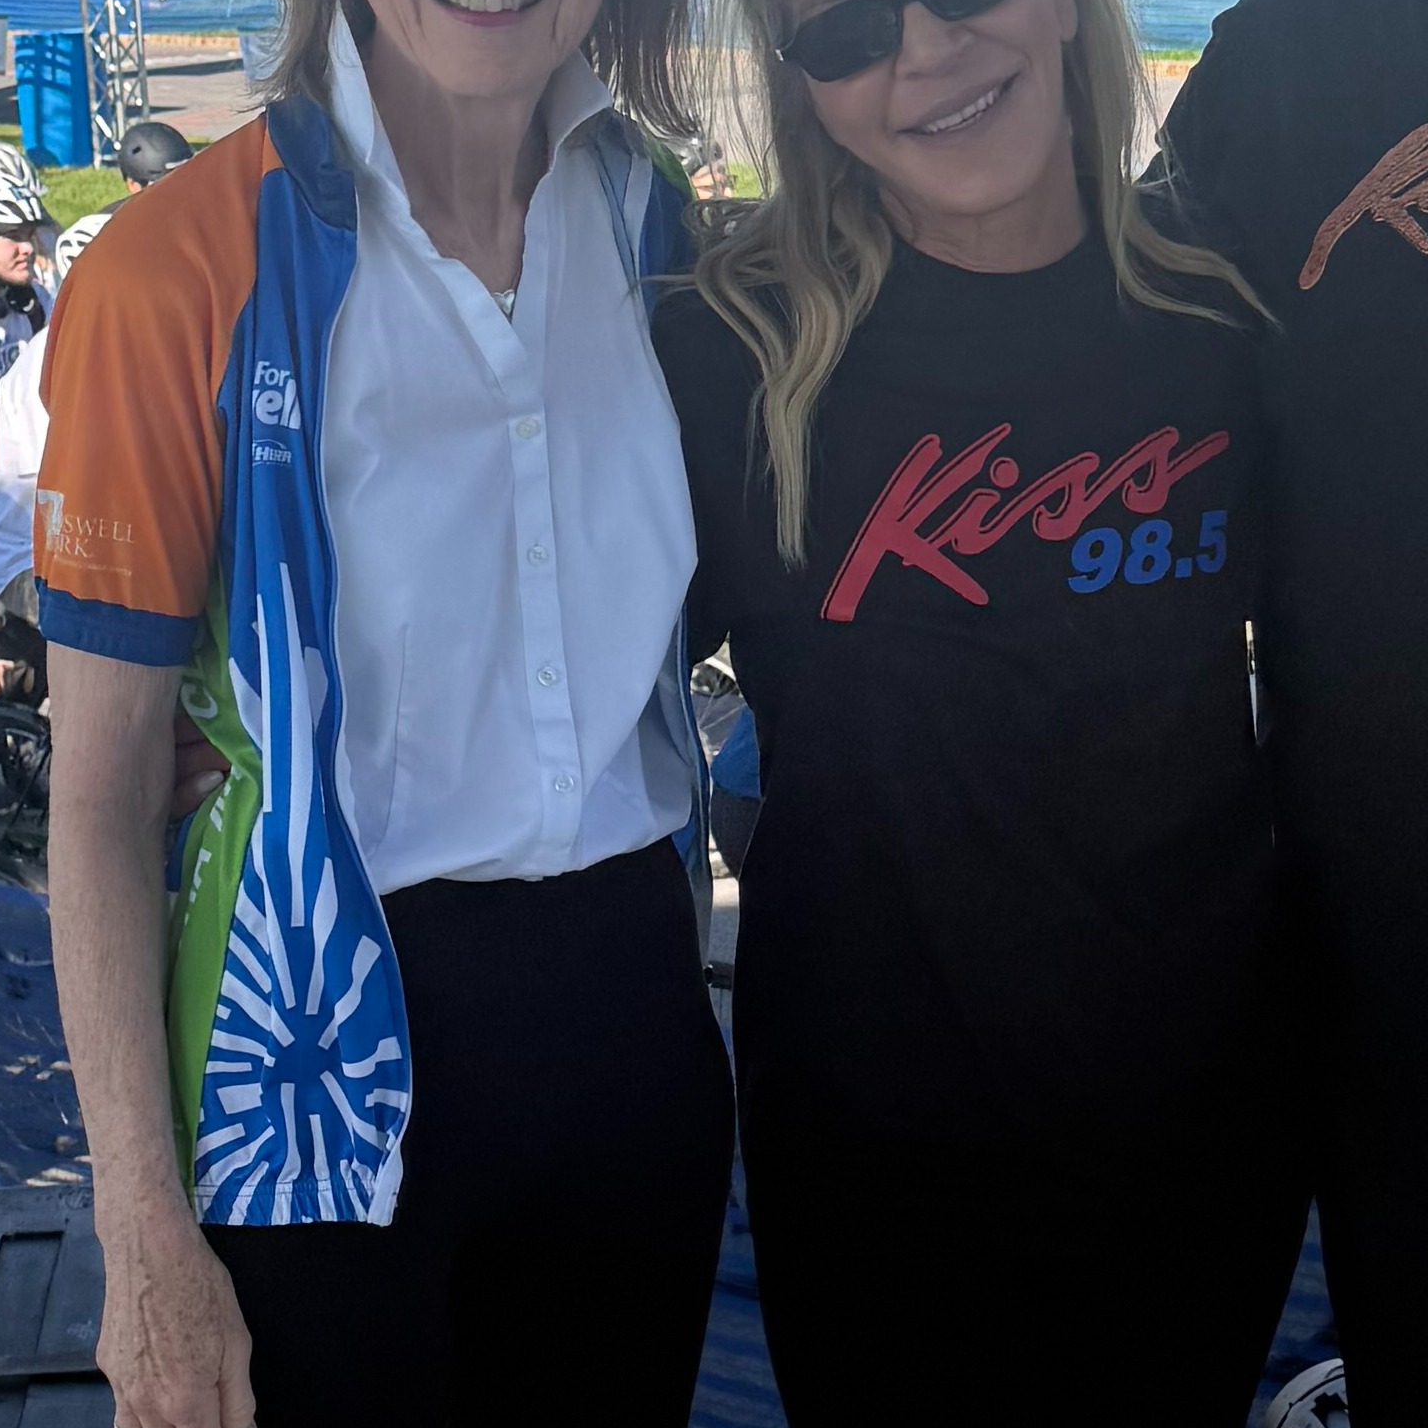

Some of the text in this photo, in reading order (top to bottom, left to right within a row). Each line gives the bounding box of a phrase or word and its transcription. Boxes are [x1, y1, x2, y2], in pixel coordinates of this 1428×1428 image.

[254, 360, 291, 387] For
[821, 422, 1229, 622] Kiss
[1068, 510, 1229, 594] 98.5
